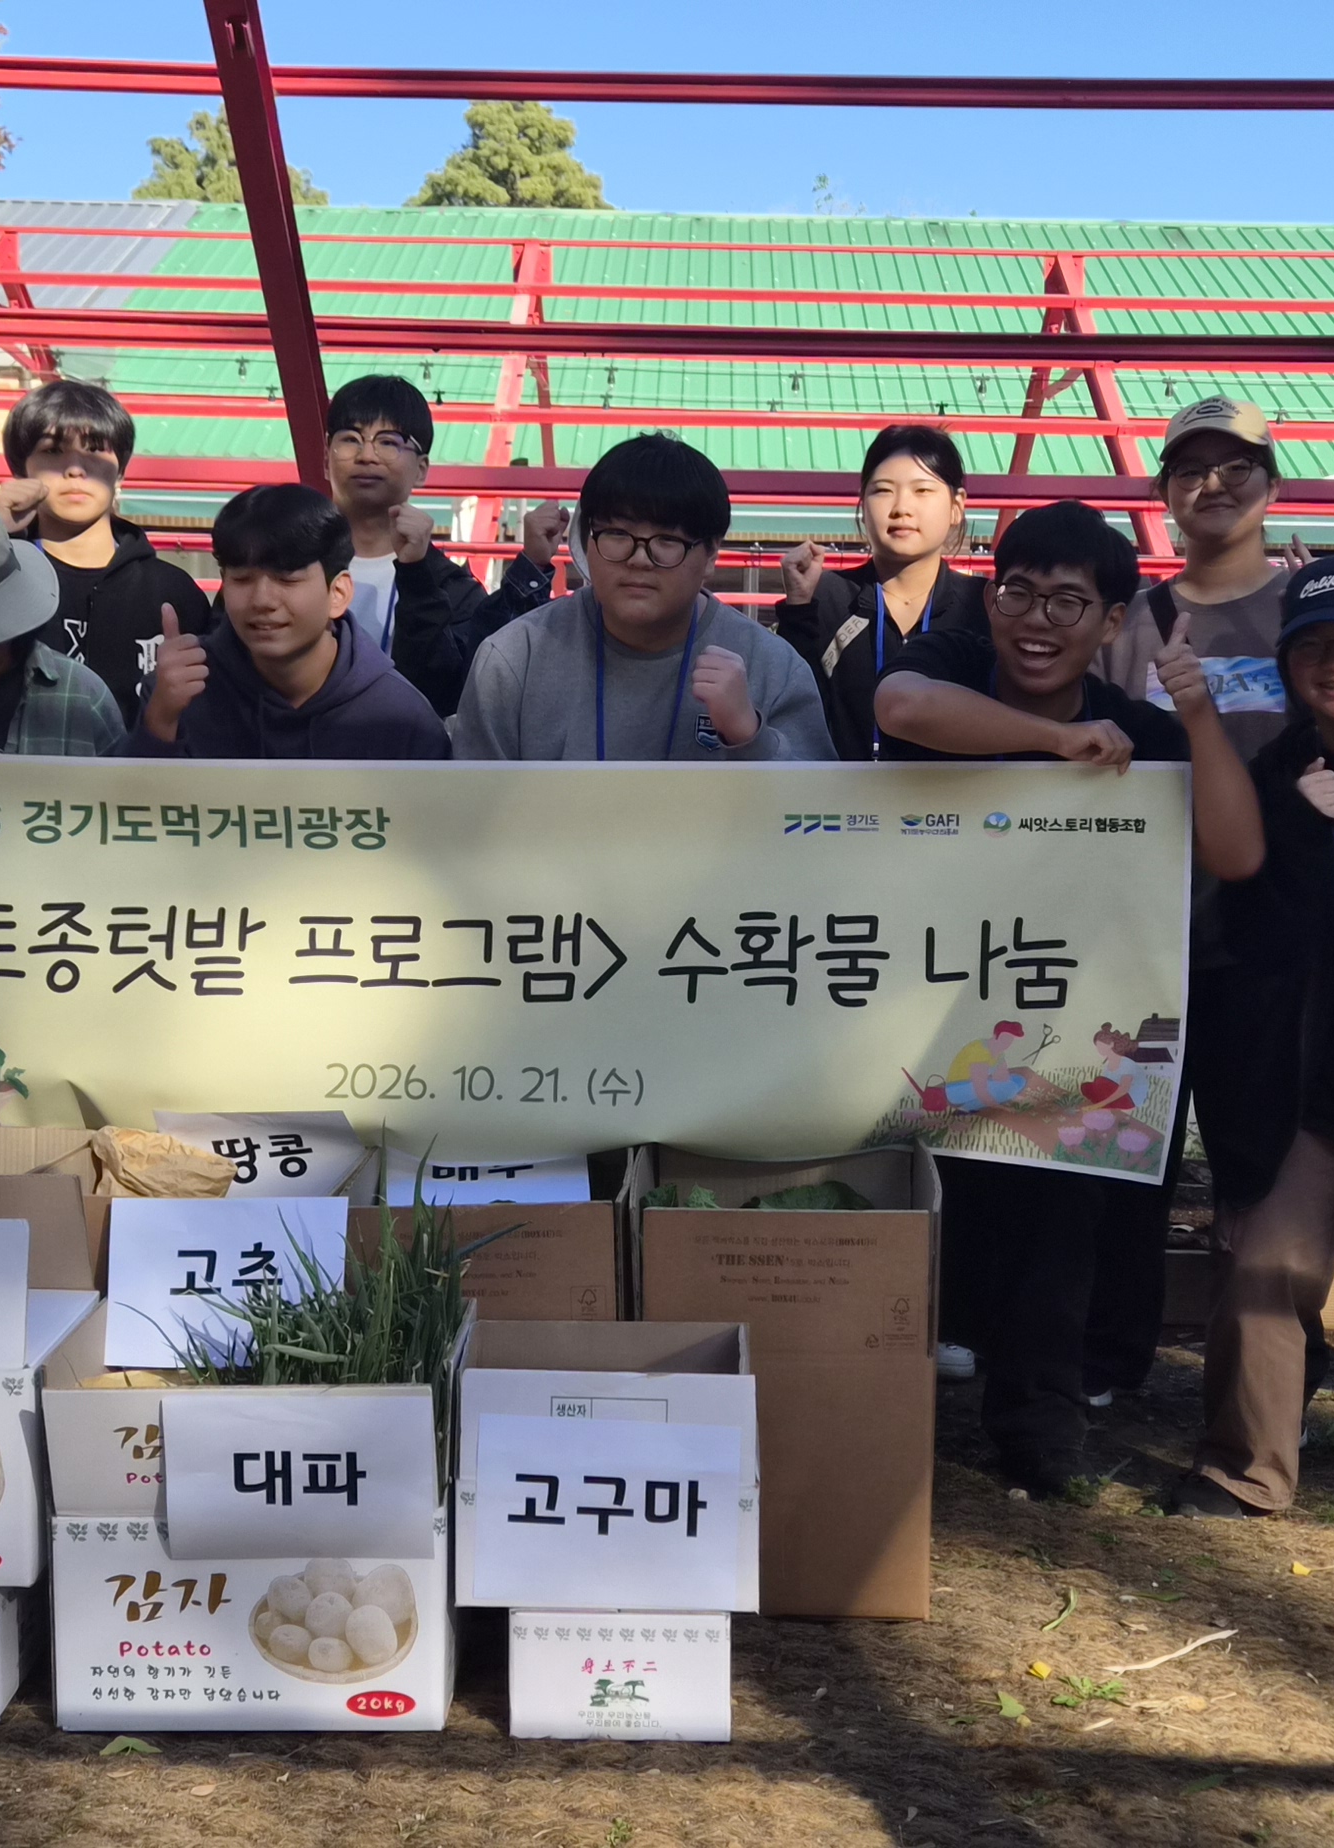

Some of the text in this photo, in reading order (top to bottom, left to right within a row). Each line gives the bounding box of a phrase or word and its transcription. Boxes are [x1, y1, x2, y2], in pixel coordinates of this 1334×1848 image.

[823, 618, 863, 670] SPDER
[21, 799, 391, 851] 경기도먹거리광장
[846, 814, 880, 827] 경기도
[925, 813, 960, 827] GAFI
[1018, 817, 1147, 834] 씨앗스토리 협동조합
[657, 911, 890, 1008] 수확물
[925, 916, 1079, 1010] 나눔
[324, 1063, 645, 1107] 2026. 10. 21. (수)
[211, 1133, 314, 1185] 땅콩
[170, 1241, 283, 1300] 고추
[556, 1403, 587, 1417] 생산자
[113, 1423, 164, 1460] 감
[233, 1450, 367, 1506] 대파
[507, 1473, 708, 1538] 고구마
[104, 1569, 233, 1623] 감자
[118, 1640, 212, 1658] Potato
[90, 1664, 232, 1679] 자연의 향기가 깃든
[92, 1686, 281, 1703] 신선한 감자만 담았습니다
[356, 1696, 406, 1714] 20kg
